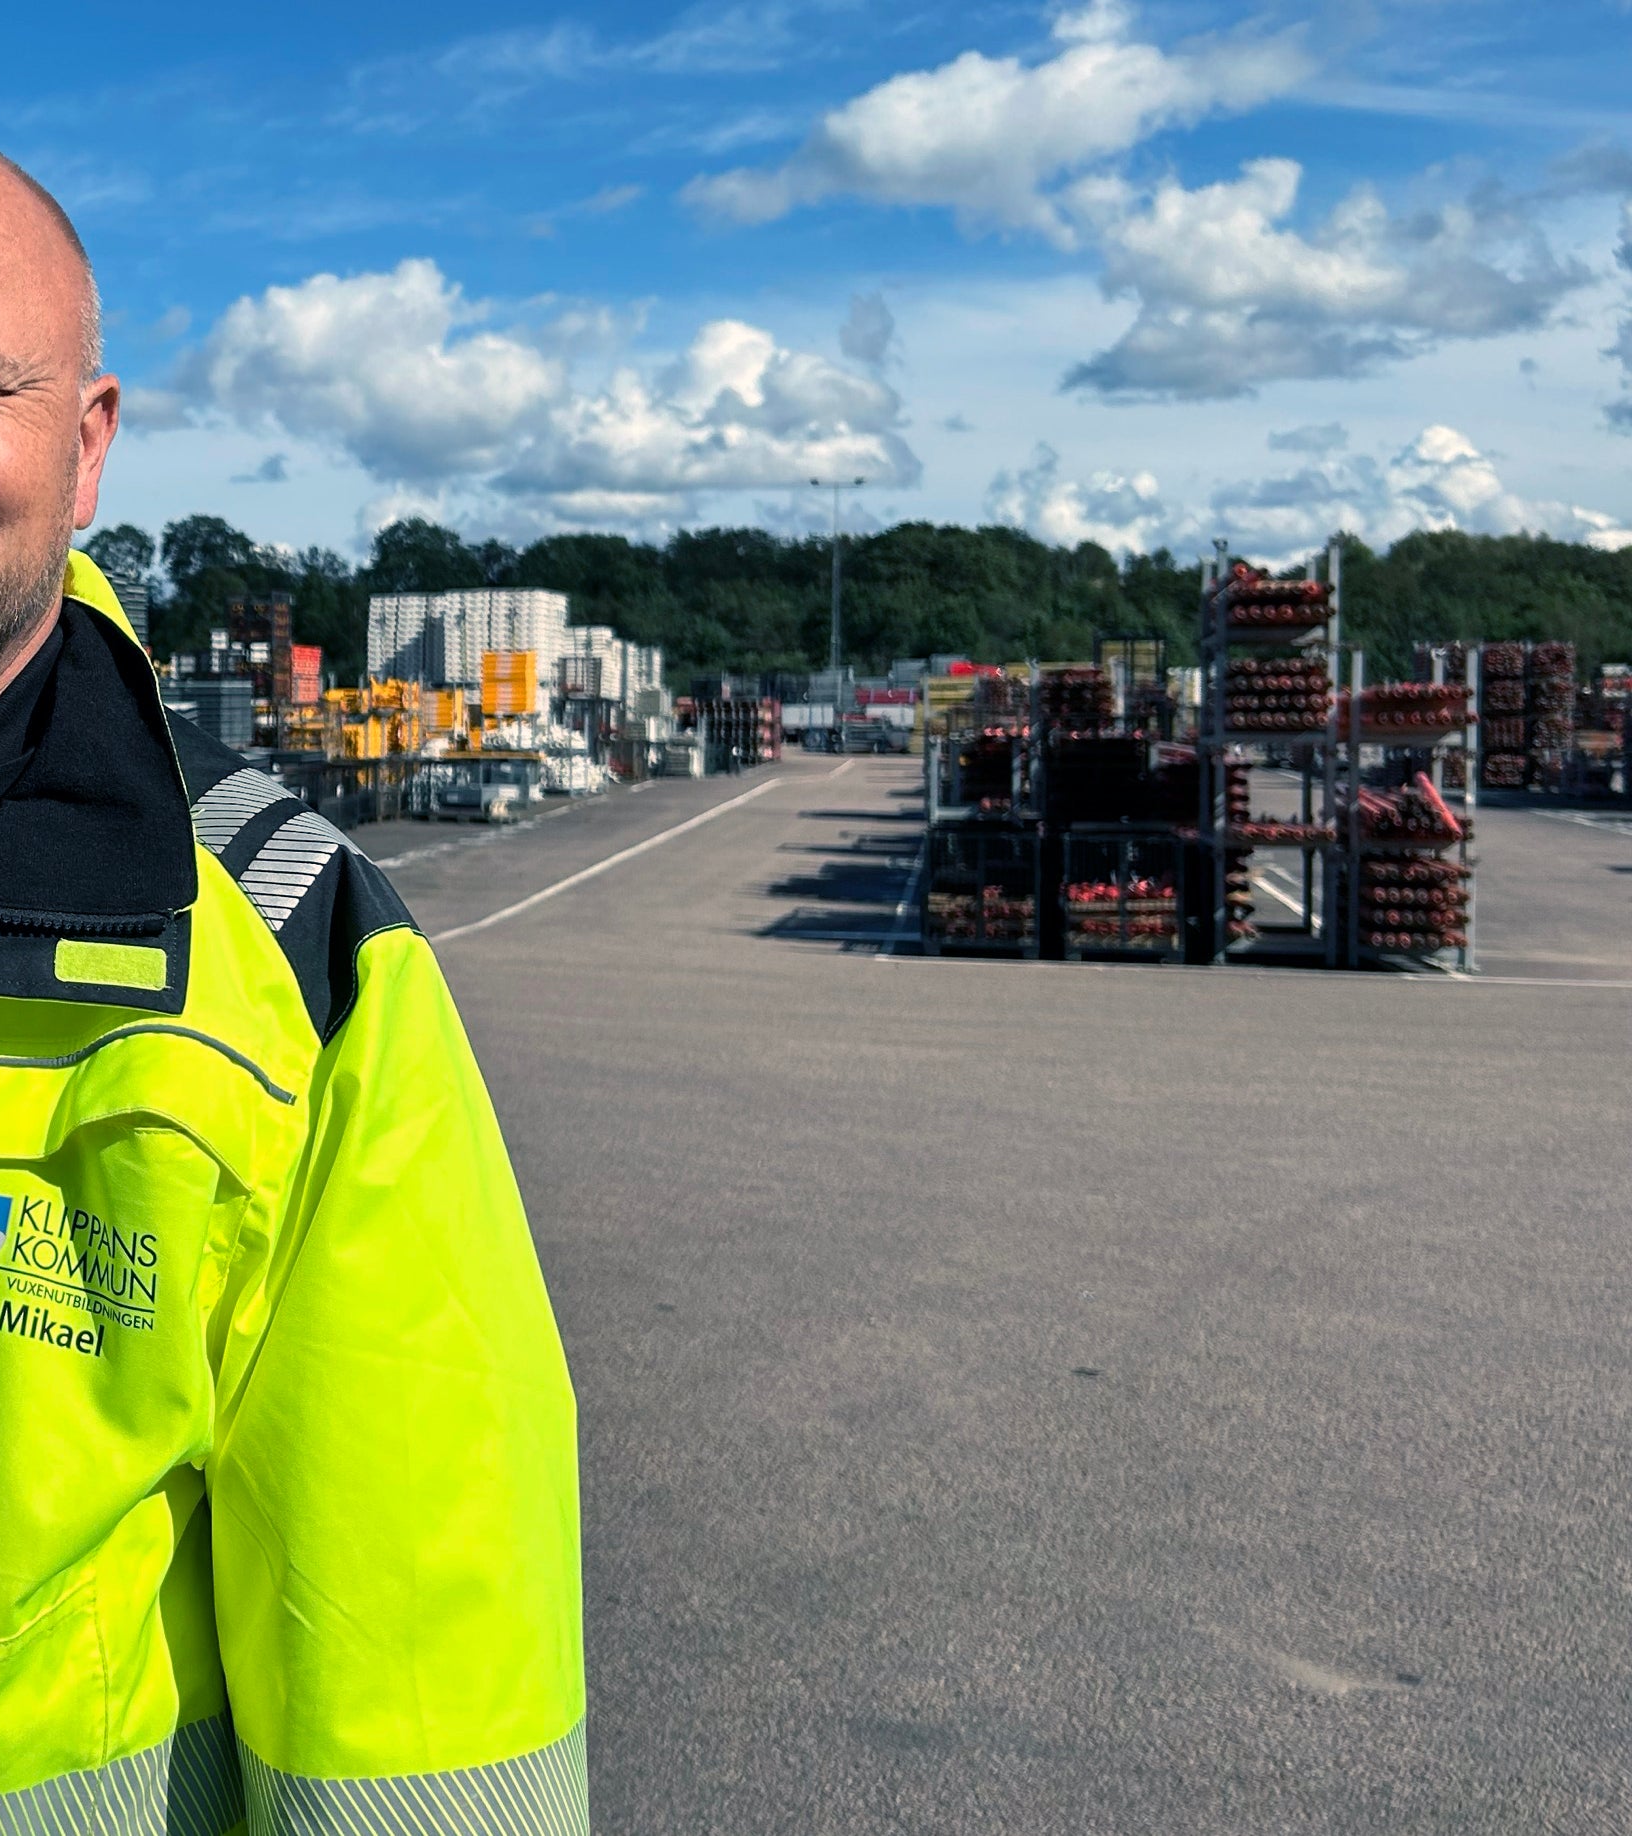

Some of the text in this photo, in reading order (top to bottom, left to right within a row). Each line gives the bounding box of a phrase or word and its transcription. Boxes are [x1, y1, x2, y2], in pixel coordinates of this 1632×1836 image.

[19, 1196, 156, 1267] KLIPPANS
[7, 1276, 154, 1331] VUXENUTBILDNINGEN
[11, 1232, 156, 1304] KOMMUN
